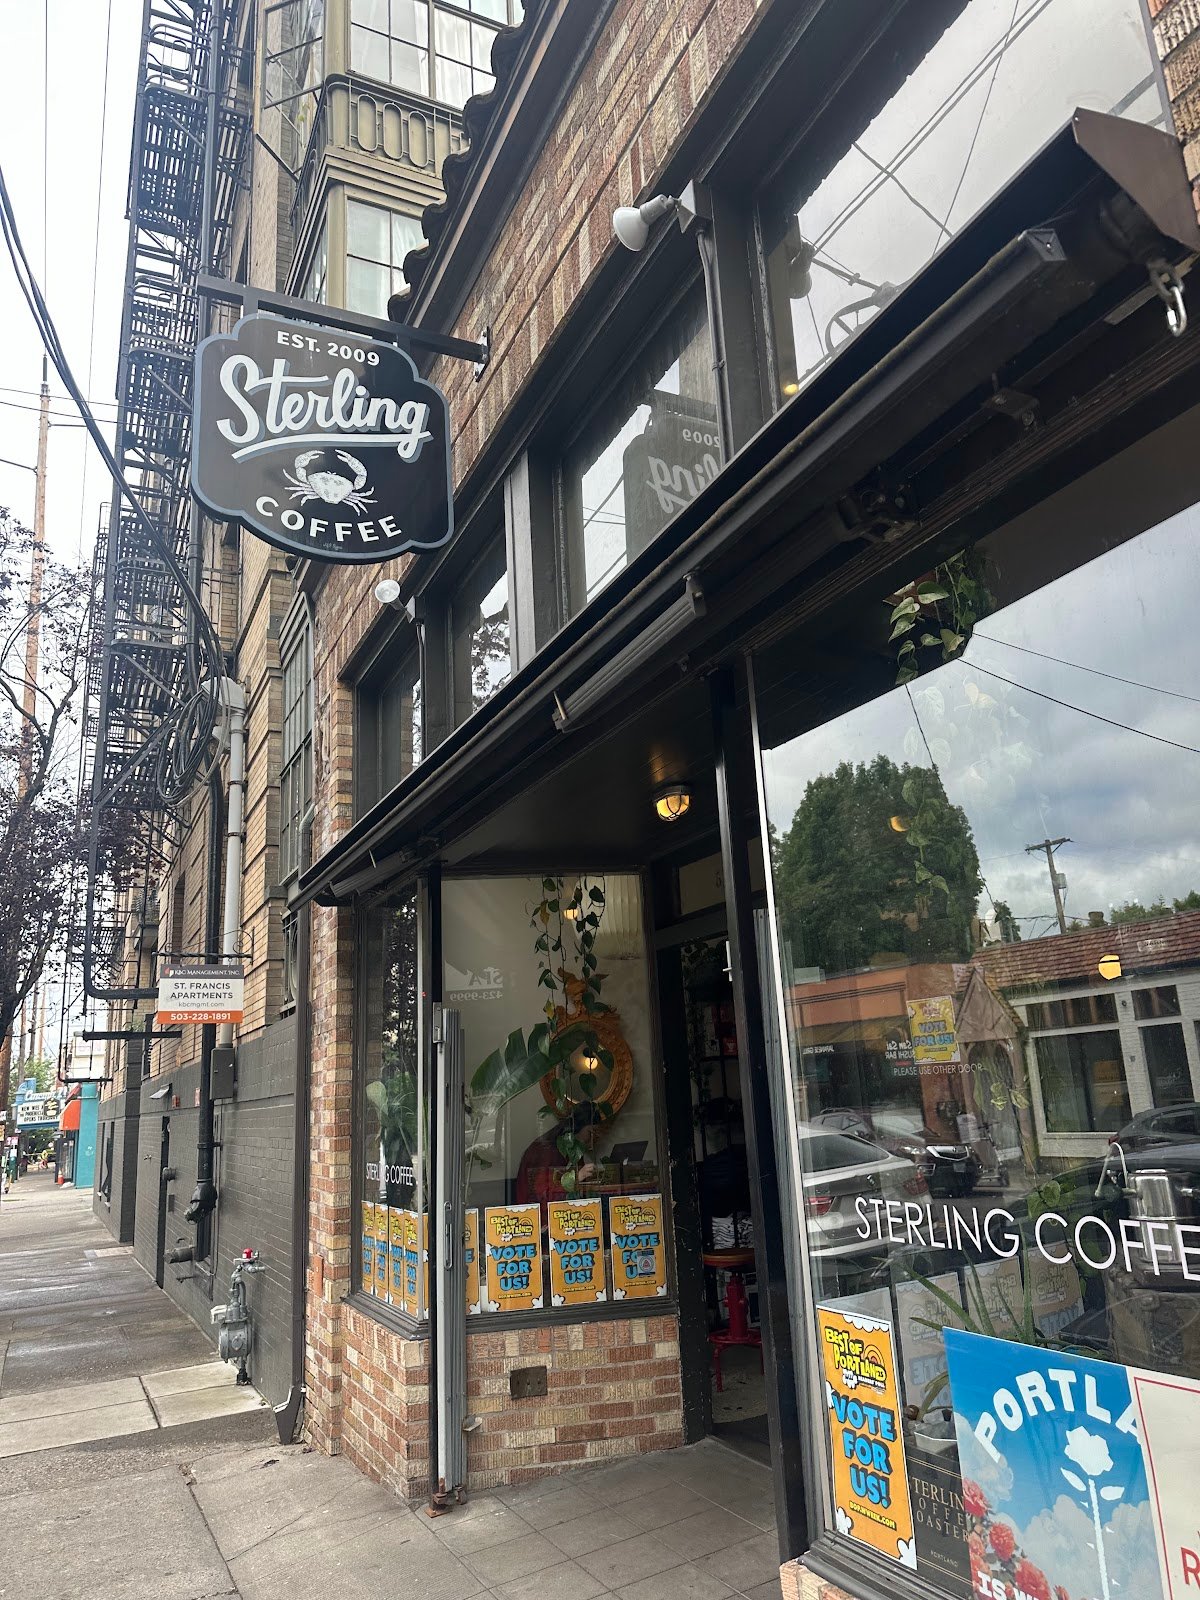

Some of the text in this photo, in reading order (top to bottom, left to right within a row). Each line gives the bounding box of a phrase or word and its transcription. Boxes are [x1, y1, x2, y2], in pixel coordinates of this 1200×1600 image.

[277, 330, 380, 366] EST. 2009
[216, 354, 433, 462] Sterling
[255, 495, 402, 543] COFFEE
[174, 982, 231, 990] ST. FRANCIS
[170, 1012, 231, 1021] 503-228-1891
[918, 1020, 947, 1034] VOTE
[914, 1032, 955, 1047] FOR US!
[893, 1063, 983, 1077] PLEASE USE OTHER DOOR
[390, 1164, 414, 1186] COFFEE
[553, 1209, 572, 1220] BEST
[614, 1204, 632, 1215] BEST
[490, 1215, 509, 1227] BEST
[559, 1217, 596, 1229] PORTLAND
[620, 1213, 656, 1224] PORTLAND
[854, 1196, 1020, 1258] STERLING
[496, 1223, 533, 1236] PORTLAND
[554, 1237, 599, 1255] VOTE
[615, 1232, 660, 1249] VOTE
[490, 1243, 537, 1261] VOTE
[497, 1260, 532, 1276] FOR
[561, 1253, 595, 1270] FOR
[500, 1275, 529, 1291] US!
[564, 1268, 593, 1285] US!
[824, 1326, 865, 1355] BEST OF
[833, 1342, 887, 1382] PORTLAND
[831, 1390, 897, 1442] VOTE
[842, 1427, 893, 1475] FOR
[849, 1463, 892, 1509] US!
[911, 1476, 965, 1512] TERLIN
[918, 1497, 965, 1527] OFFE
[916, 1510, 969, 1542] OASTER
[977, 1570, 1008, 1600] IS
